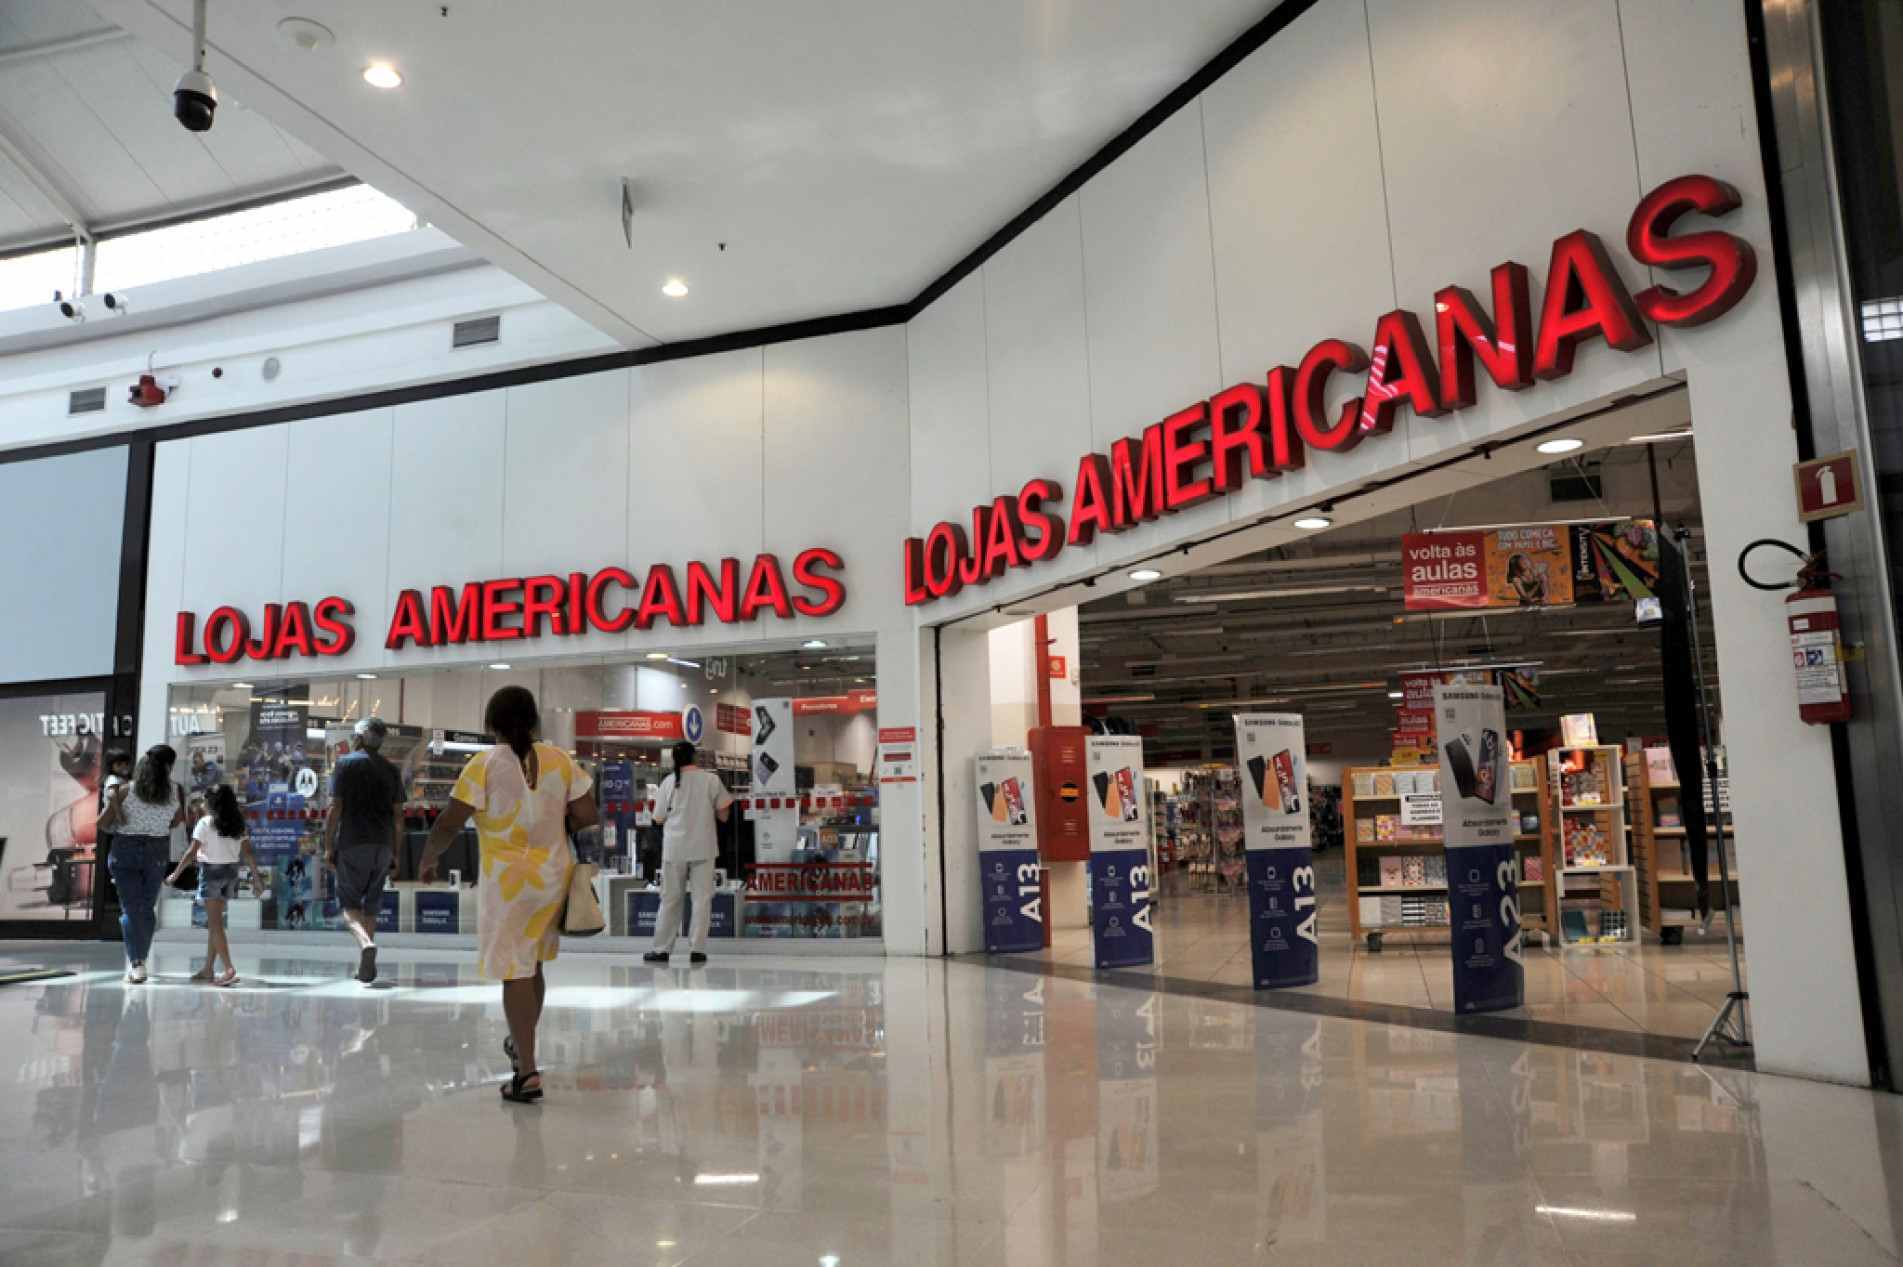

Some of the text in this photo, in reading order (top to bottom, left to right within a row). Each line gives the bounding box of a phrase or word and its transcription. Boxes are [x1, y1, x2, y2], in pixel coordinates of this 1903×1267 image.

[904, 174, 1757, 606] LOJAS AMERICANAS
[1409, 541, 1476, 560] volta às
[1411, 559, 1478, 582] aulas
[174, 547, 845, 666] LOJAS AMERICANAS
[1413, 584, 1479, 598] americanas
[1017, 863, 1042, 923] A13
[1130, 865, 1153, 932] A13
[1292, 865, 1318, 944] A13
[1497, 859, 1521, 968] A23
